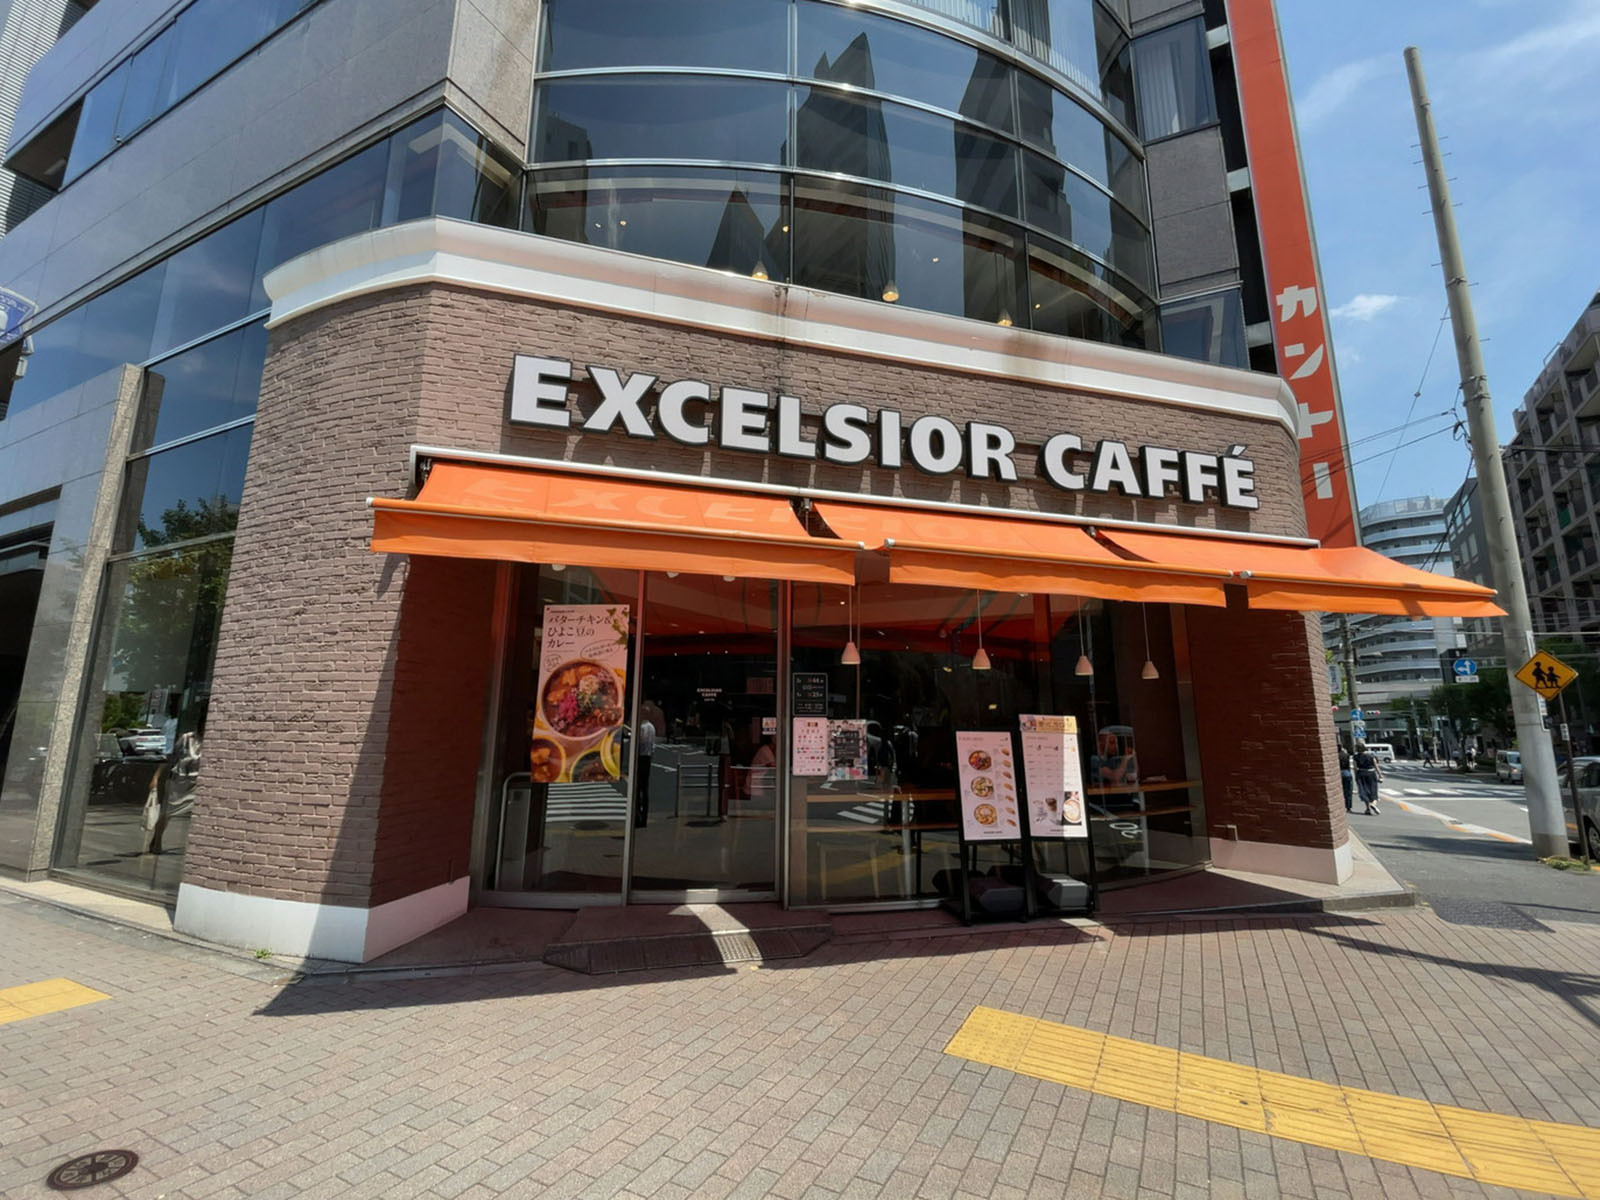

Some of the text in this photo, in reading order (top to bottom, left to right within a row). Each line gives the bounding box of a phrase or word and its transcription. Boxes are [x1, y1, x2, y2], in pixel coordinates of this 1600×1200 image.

[510, 353, 1260, 510] EXCELSIOR CAFFÉ
[547, 639, 575, 648] カレー
